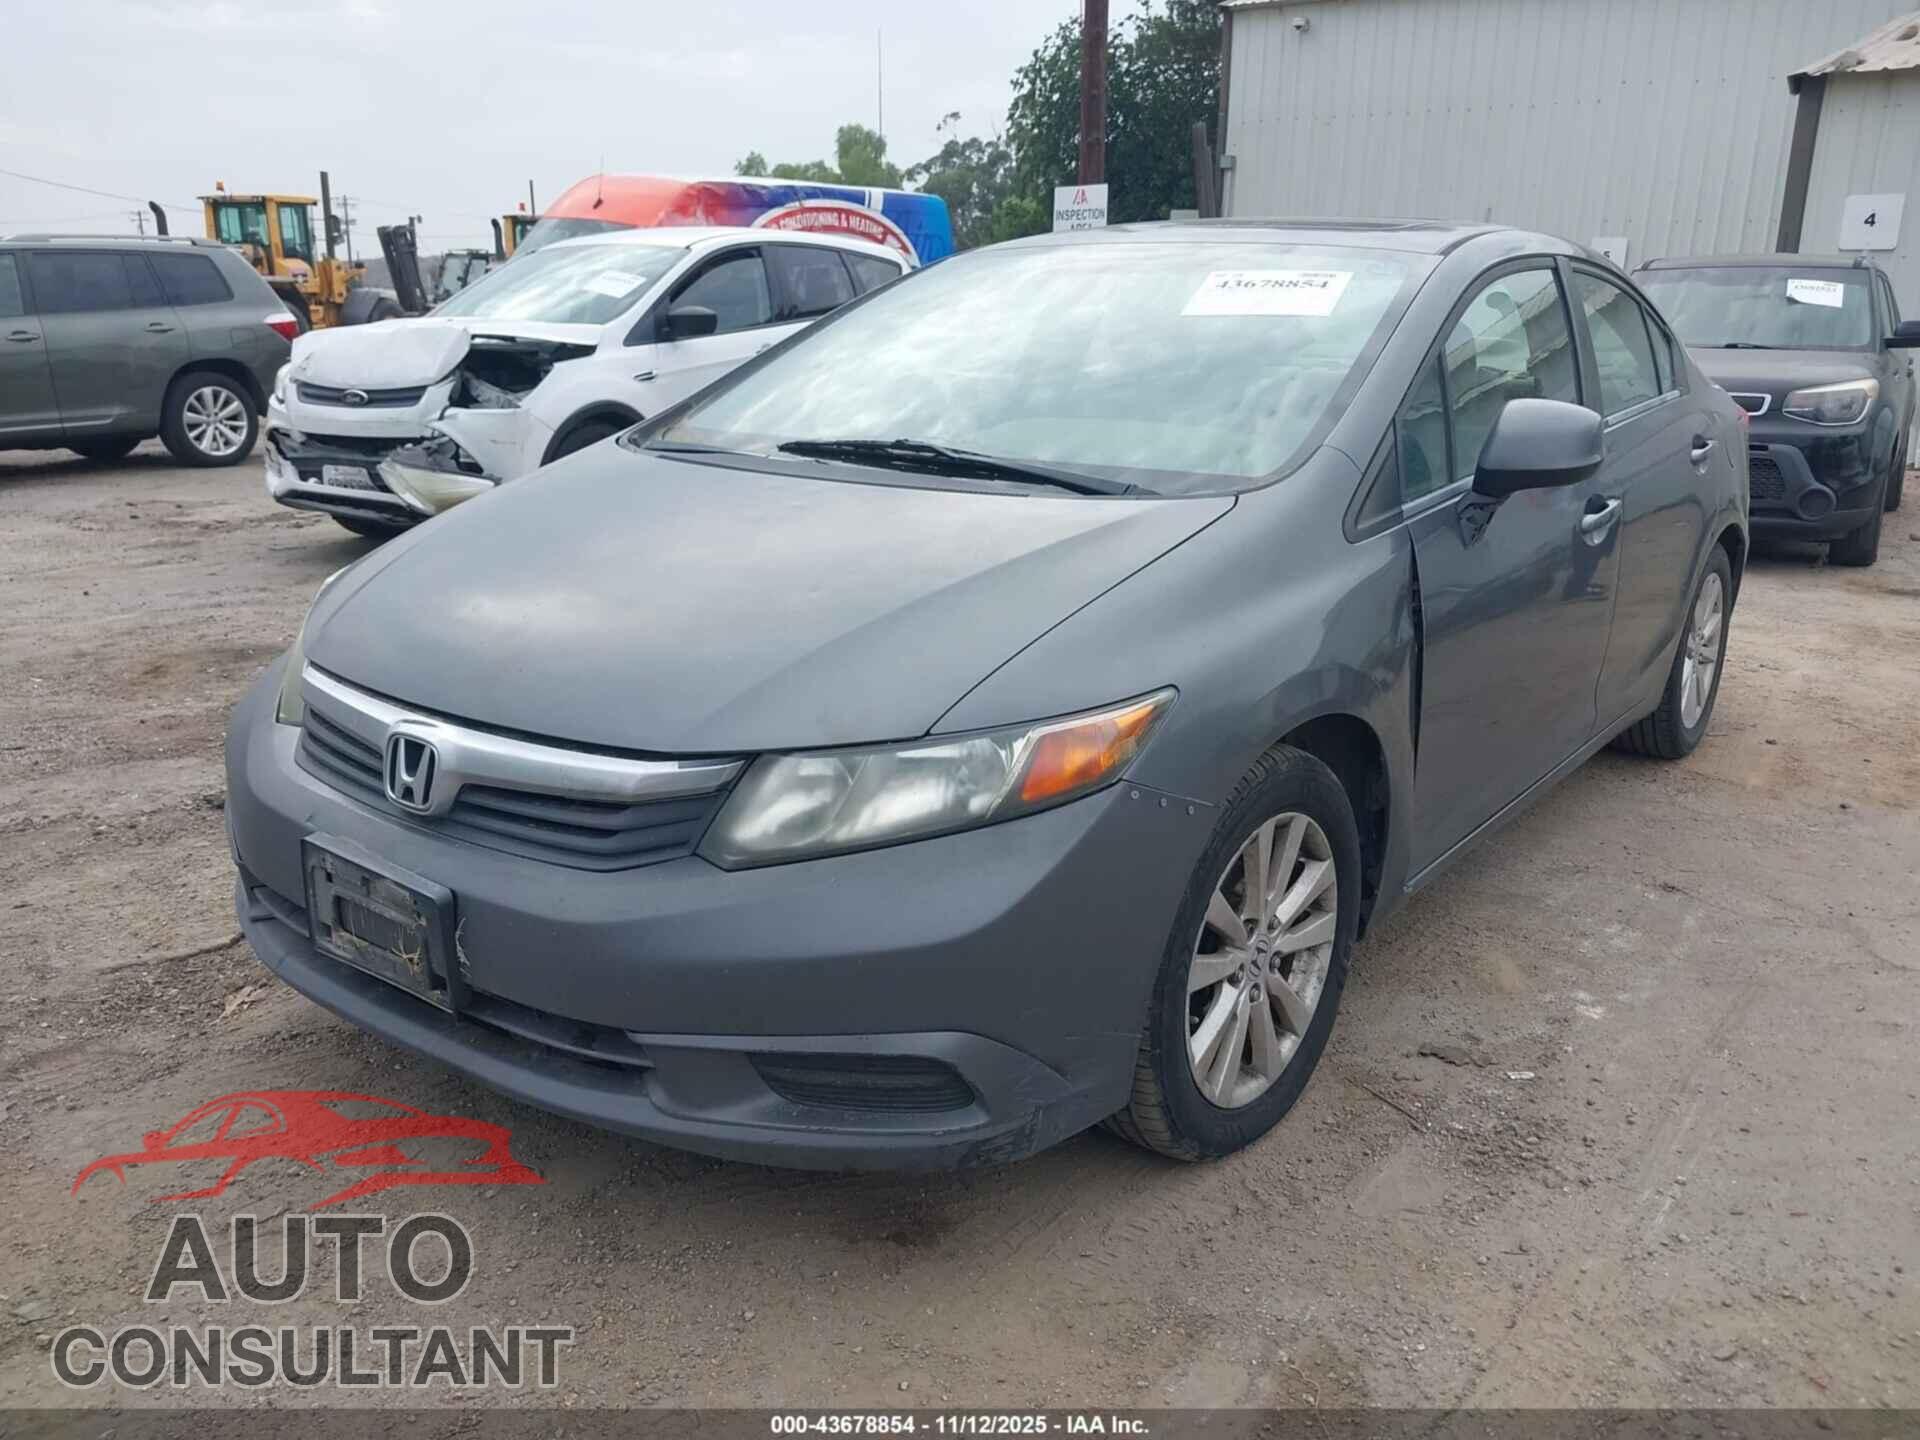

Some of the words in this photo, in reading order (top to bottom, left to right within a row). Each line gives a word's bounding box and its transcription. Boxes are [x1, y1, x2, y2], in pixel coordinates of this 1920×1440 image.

[840, 213, 848, 228] &
[1055, 208, 1105, 221] INSPECTION
[1863, 212, 1876, 227] 4
